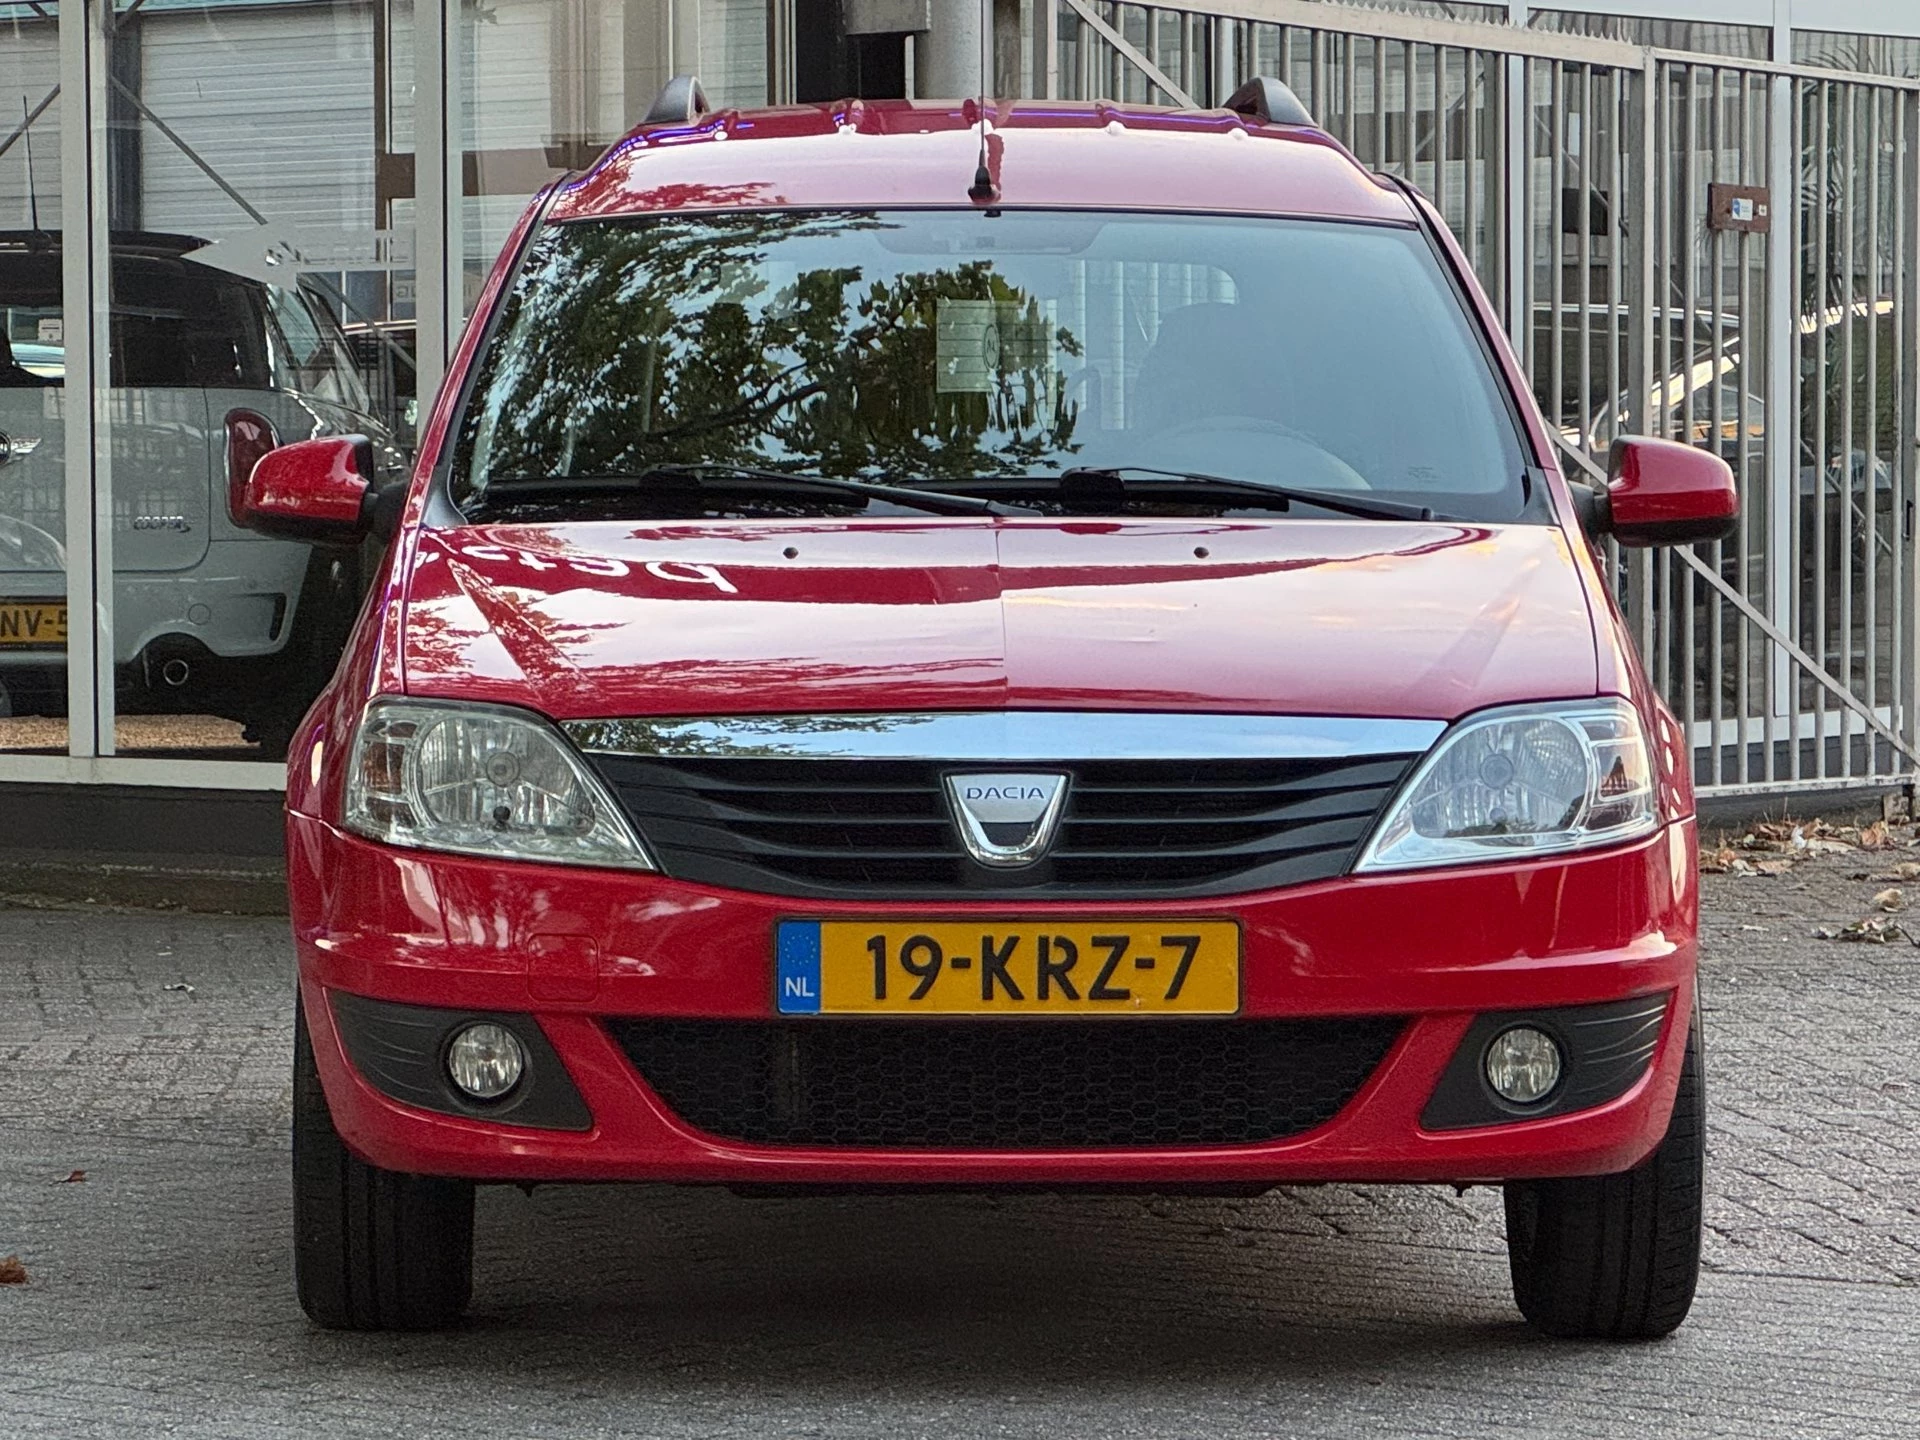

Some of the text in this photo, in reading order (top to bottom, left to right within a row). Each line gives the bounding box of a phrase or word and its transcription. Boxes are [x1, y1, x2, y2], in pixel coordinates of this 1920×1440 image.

[966, 787, 1044, 799] DACIA
[866, 935, 1201, 1001] 19-KRZ-7
[785, 976, 815, 997] NL
